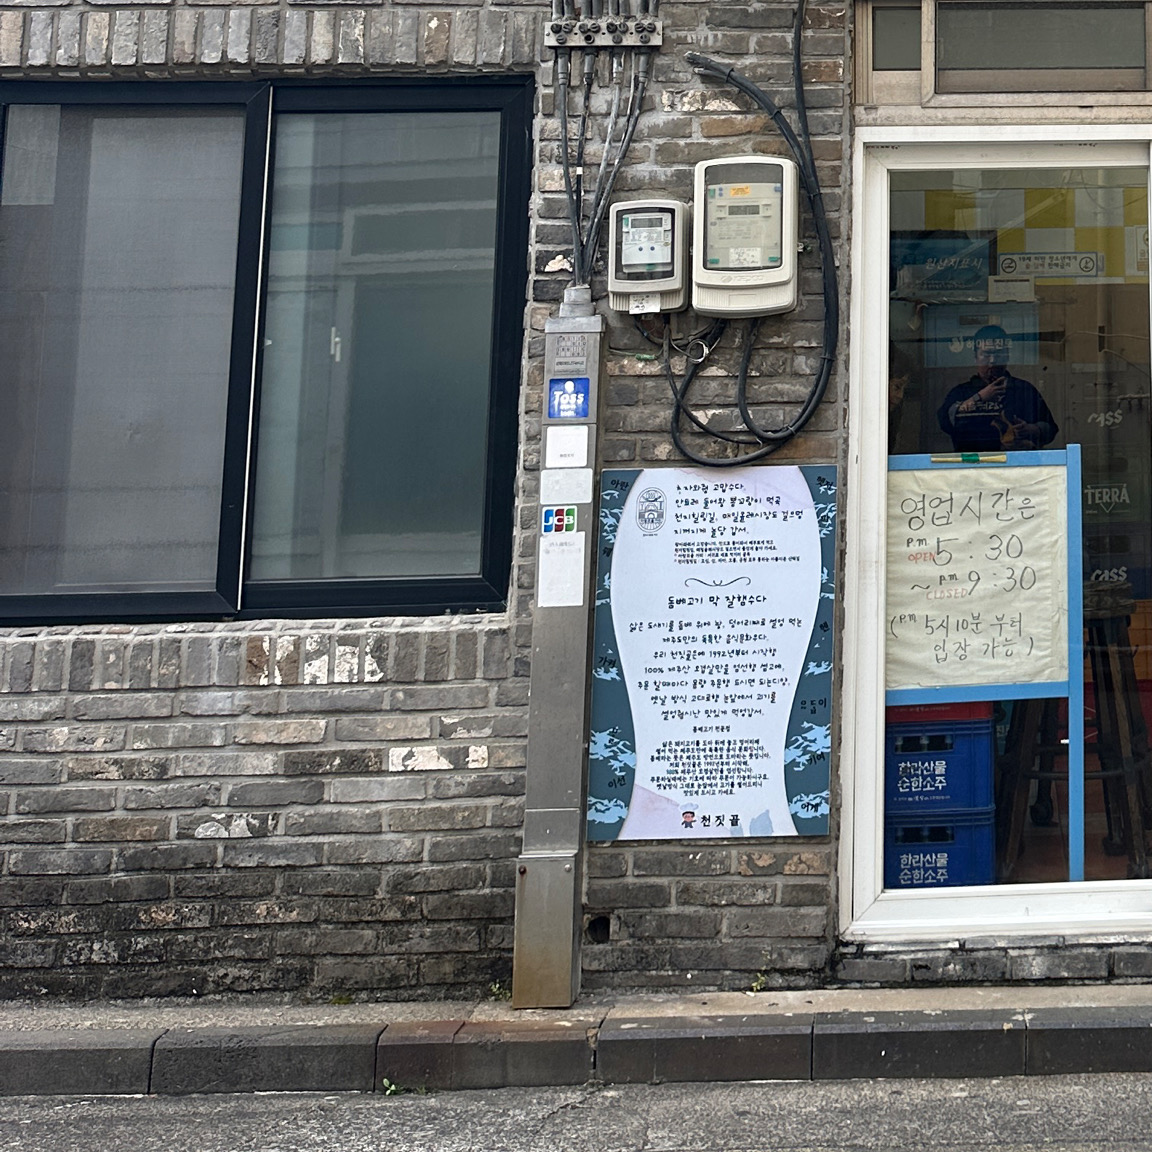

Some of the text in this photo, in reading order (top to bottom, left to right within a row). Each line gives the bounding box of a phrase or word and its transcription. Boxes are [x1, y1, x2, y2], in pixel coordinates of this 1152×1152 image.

[1084, 487, 1131, 505] TERRA
[900, 488, 1036, 531] 영업시간은
[908, 551, 936, 565] OPEN
[667, 596, 704, 609] 돔베고기
[709, 595, 720, 607] 막
[926, 587, 969, 600] CLOSED
[990, 612, 1022, 637] 부터
[933, 638, 971, 664] 입장
[644, 666, 665, 674] 100%
[898, 760, 947, 777] 한라산물
[897, 776, 948, 793] 순한소주
[899, 853, 949, 868] 한라산물
[898, 868, 949, 885] 순한소주
